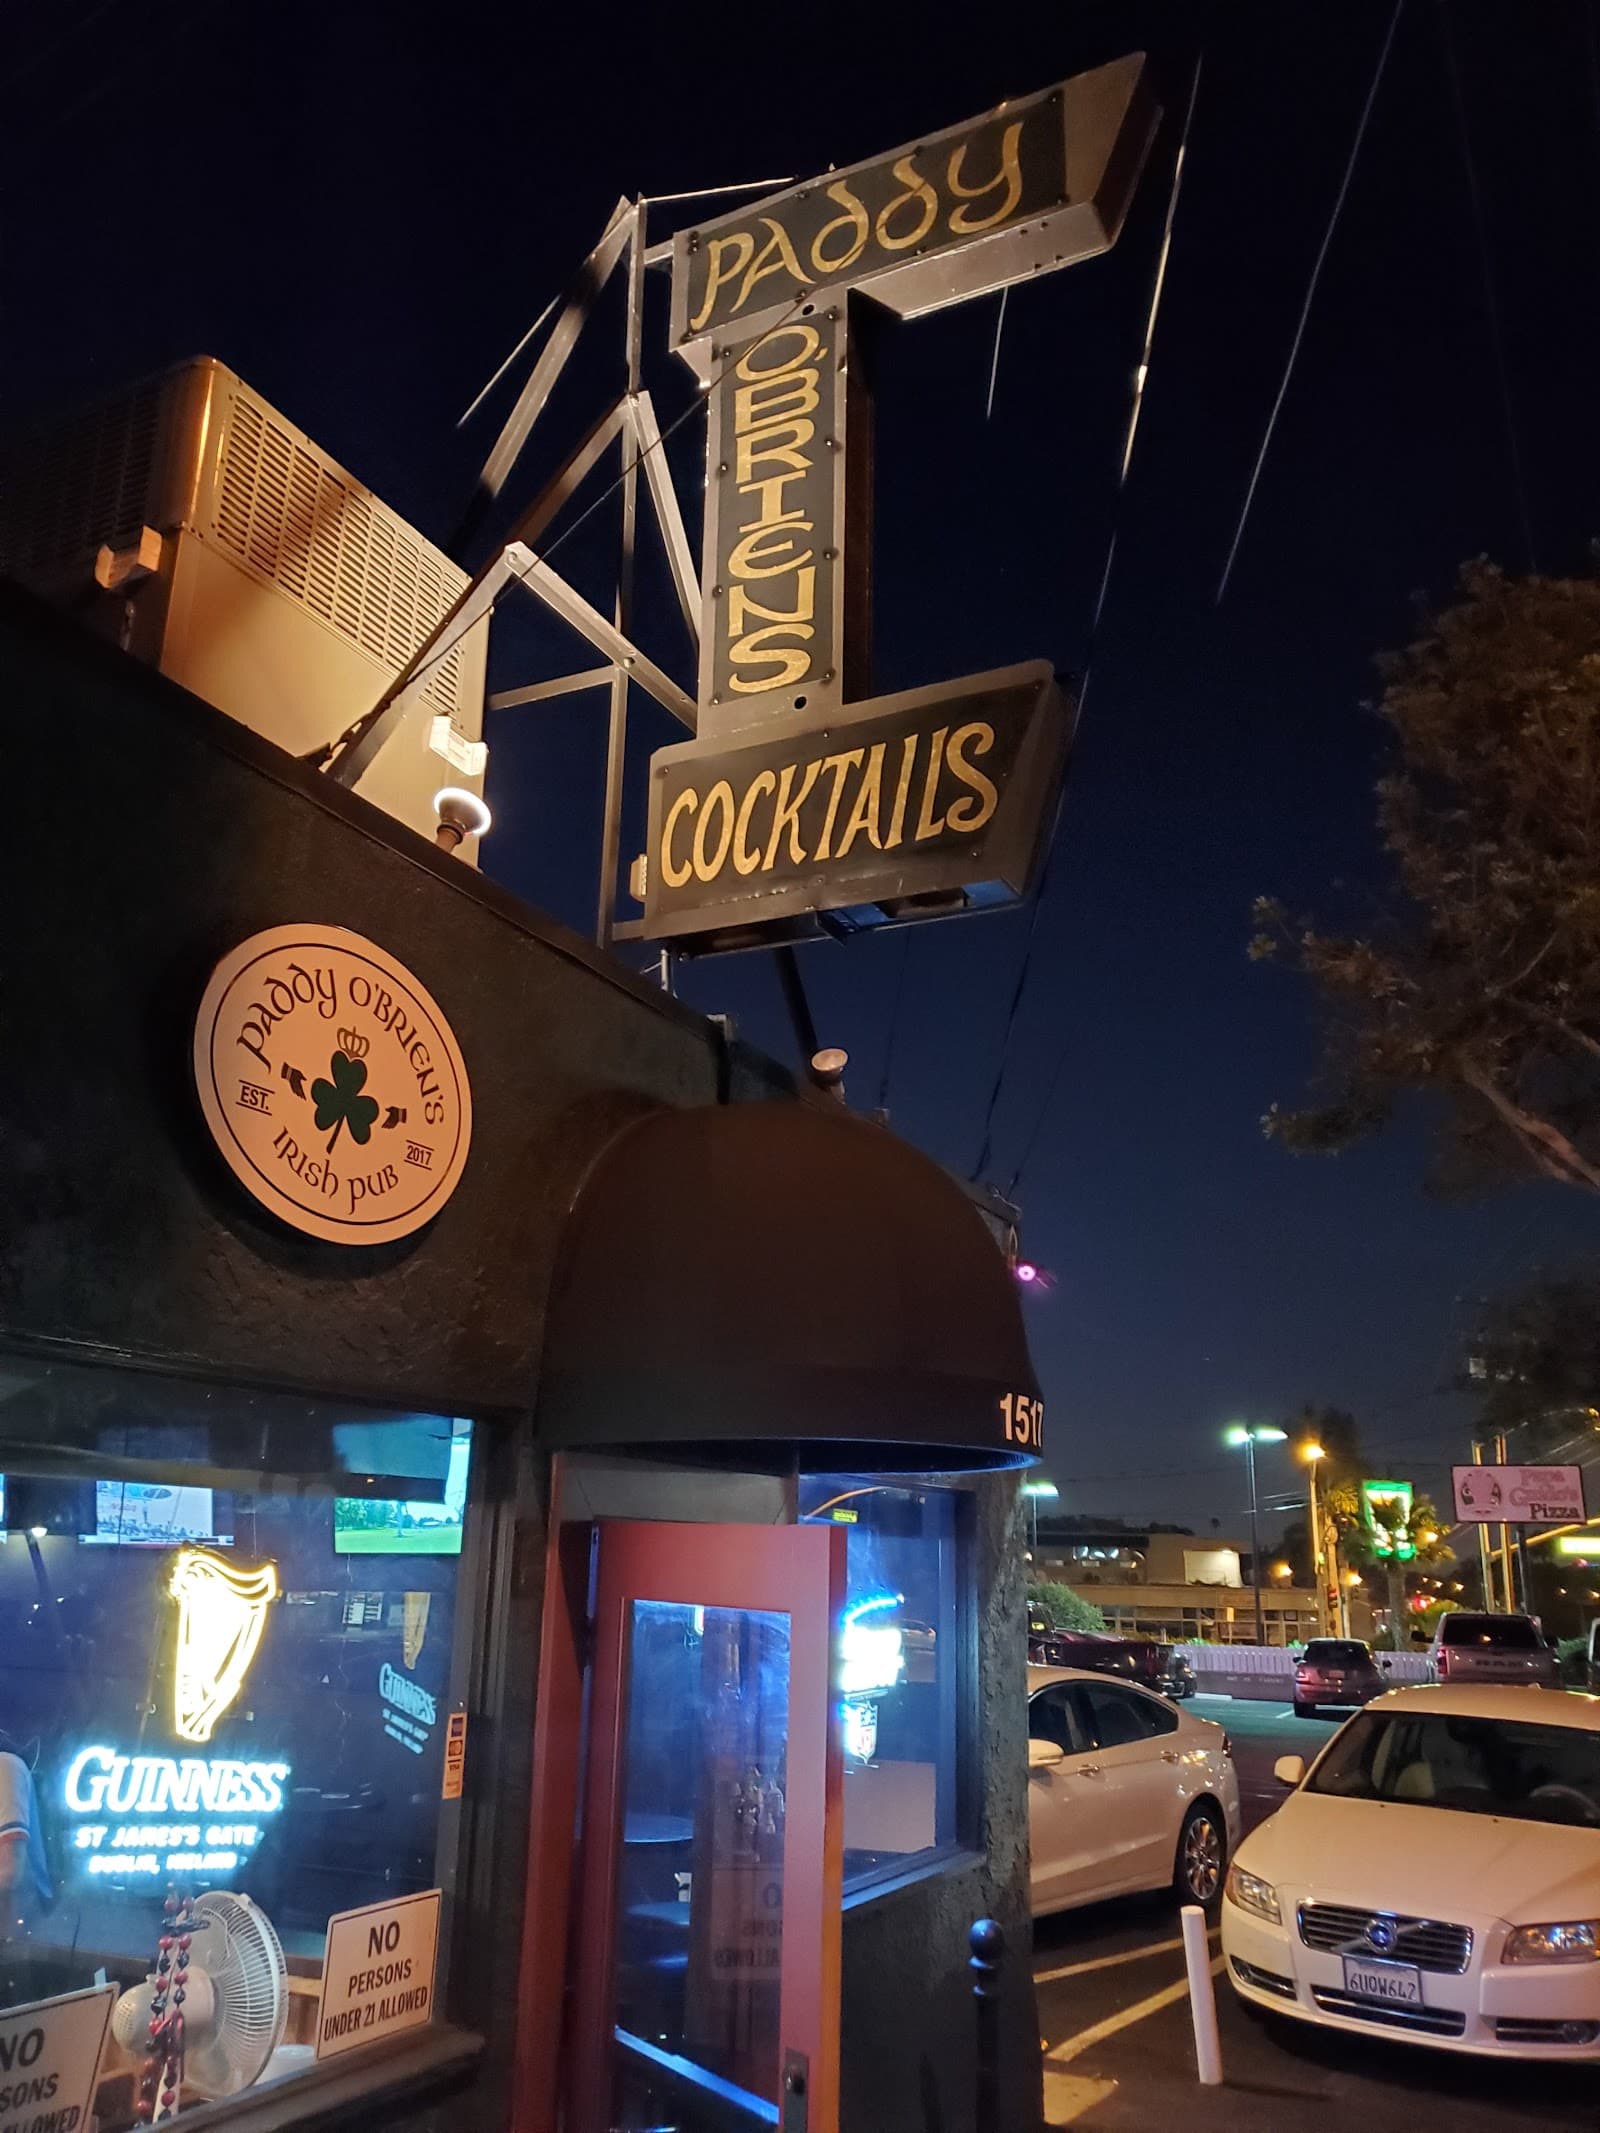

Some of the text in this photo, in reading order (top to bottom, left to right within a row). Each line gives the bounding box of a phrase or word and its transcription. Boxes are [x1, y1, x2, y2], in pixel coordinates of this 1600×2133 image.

[661, 722, 998, 888] COCKTAILS
[240, 1087, 270, 1111] EST.
[406, 1145, 432, 1166] 2017
[1000, 1392, 1044, 1448] 1517
[1529, 1503, 1580, 1519] Pizza
[65, 1746, 291, 1812] GUINNESS
[368, 1920, 400, 1958] NO
[347, 1958, 412, 1998] PERSONS
[324, 1986, 428, 2041] UNDER 21 ALLOWED
